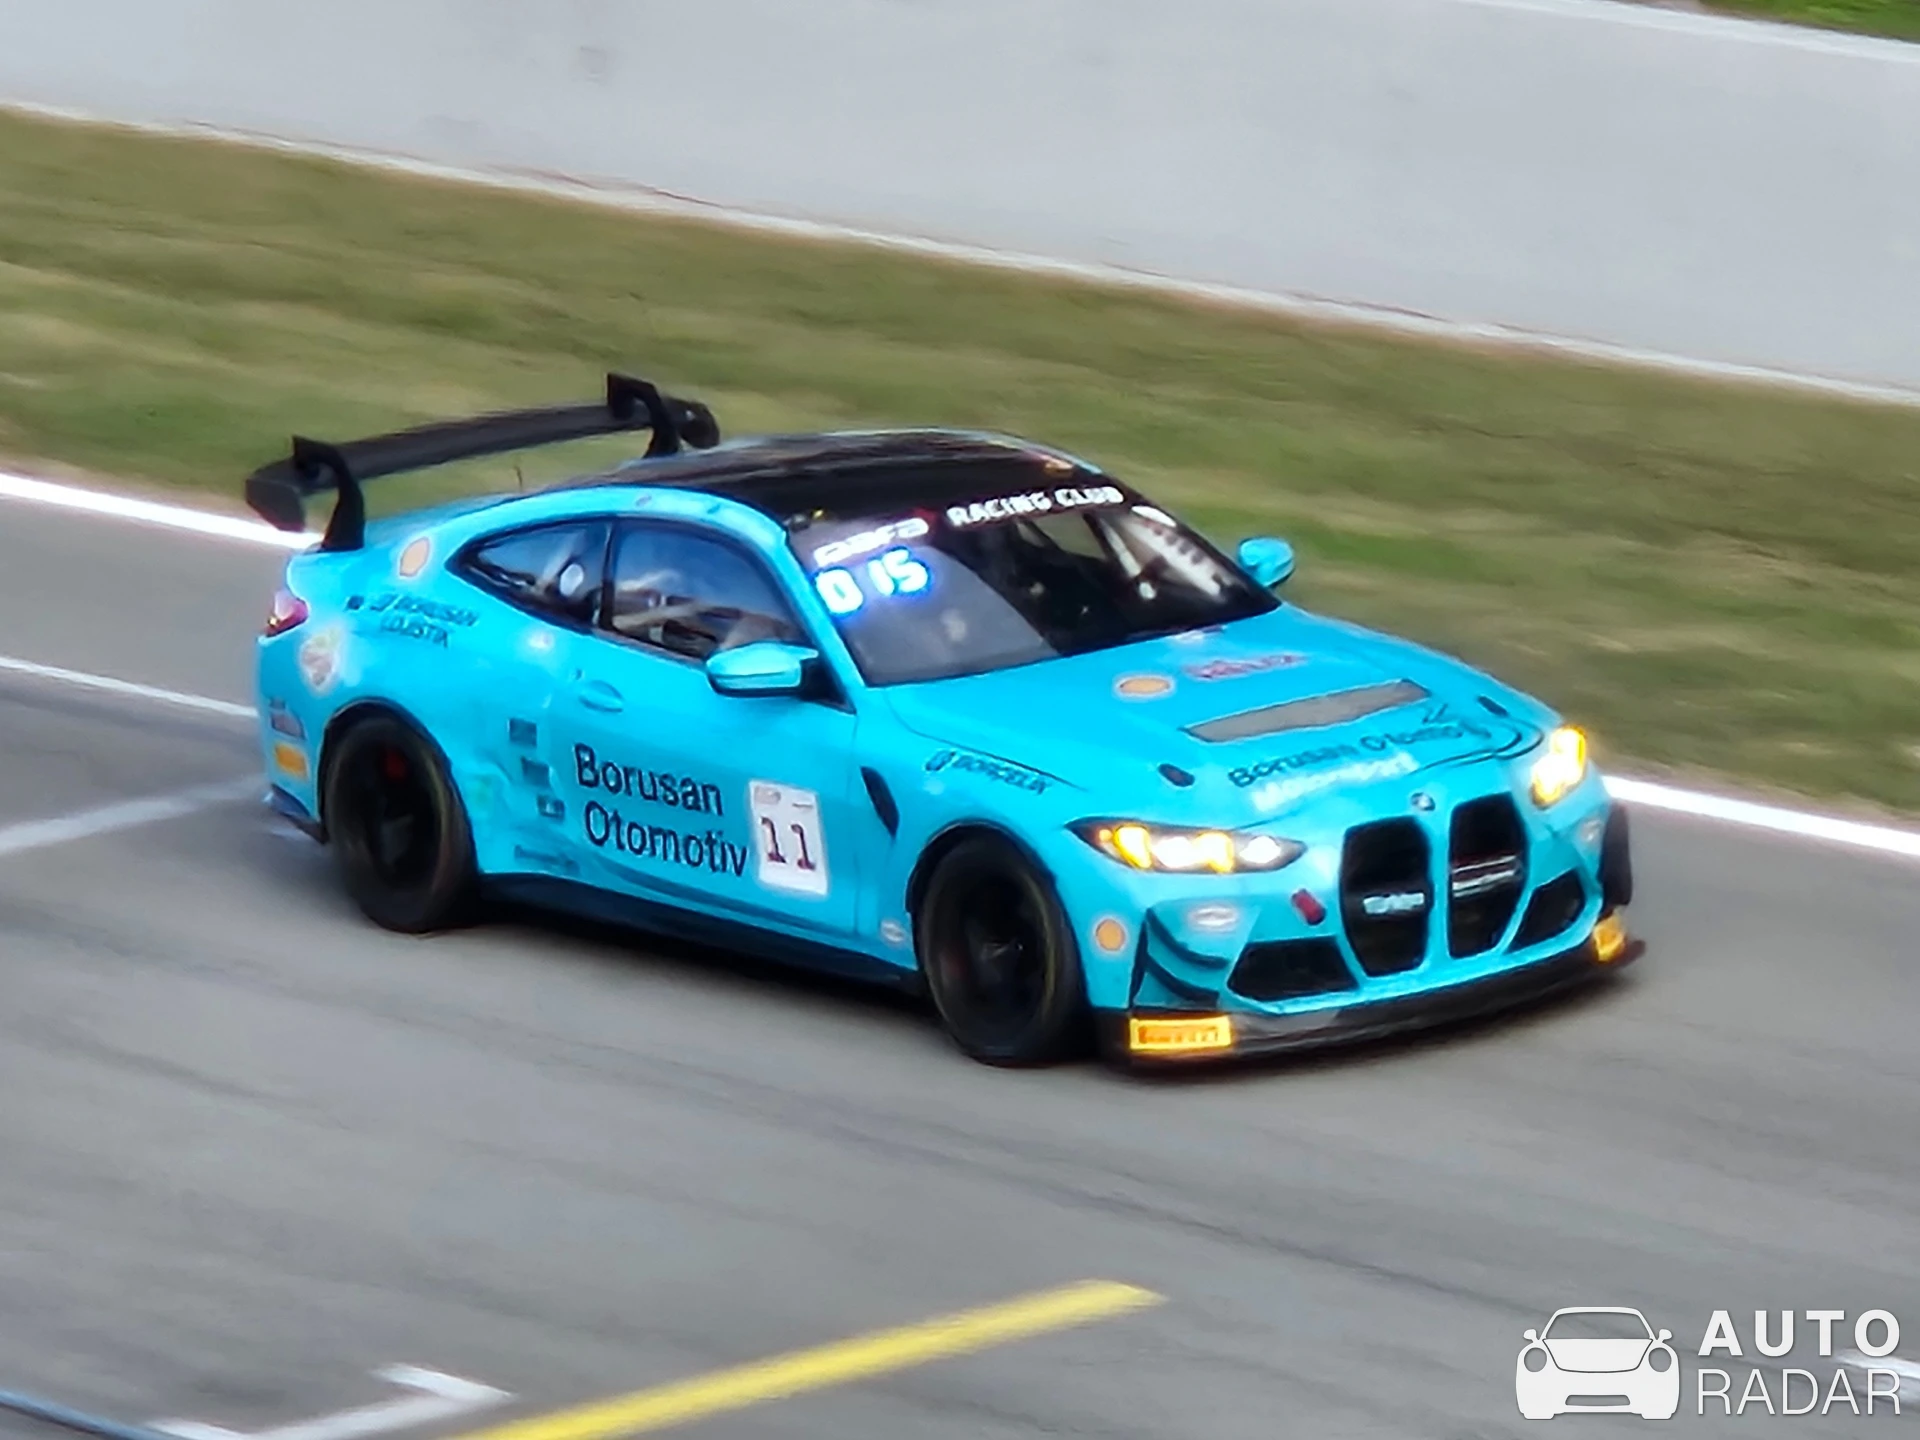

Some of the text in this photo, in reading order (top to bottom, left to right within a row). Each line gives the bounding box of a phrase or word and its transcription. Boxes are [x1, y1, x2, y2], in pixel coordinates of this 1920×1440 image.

[946, 490, 1051, 527] RACING
[1055, 486, 1124, 507] CLUB
[574, 743, 723, 816] Borusan
[585, 801, 747, 876] Otomotiv
[760, 817, 816, 870] 11
